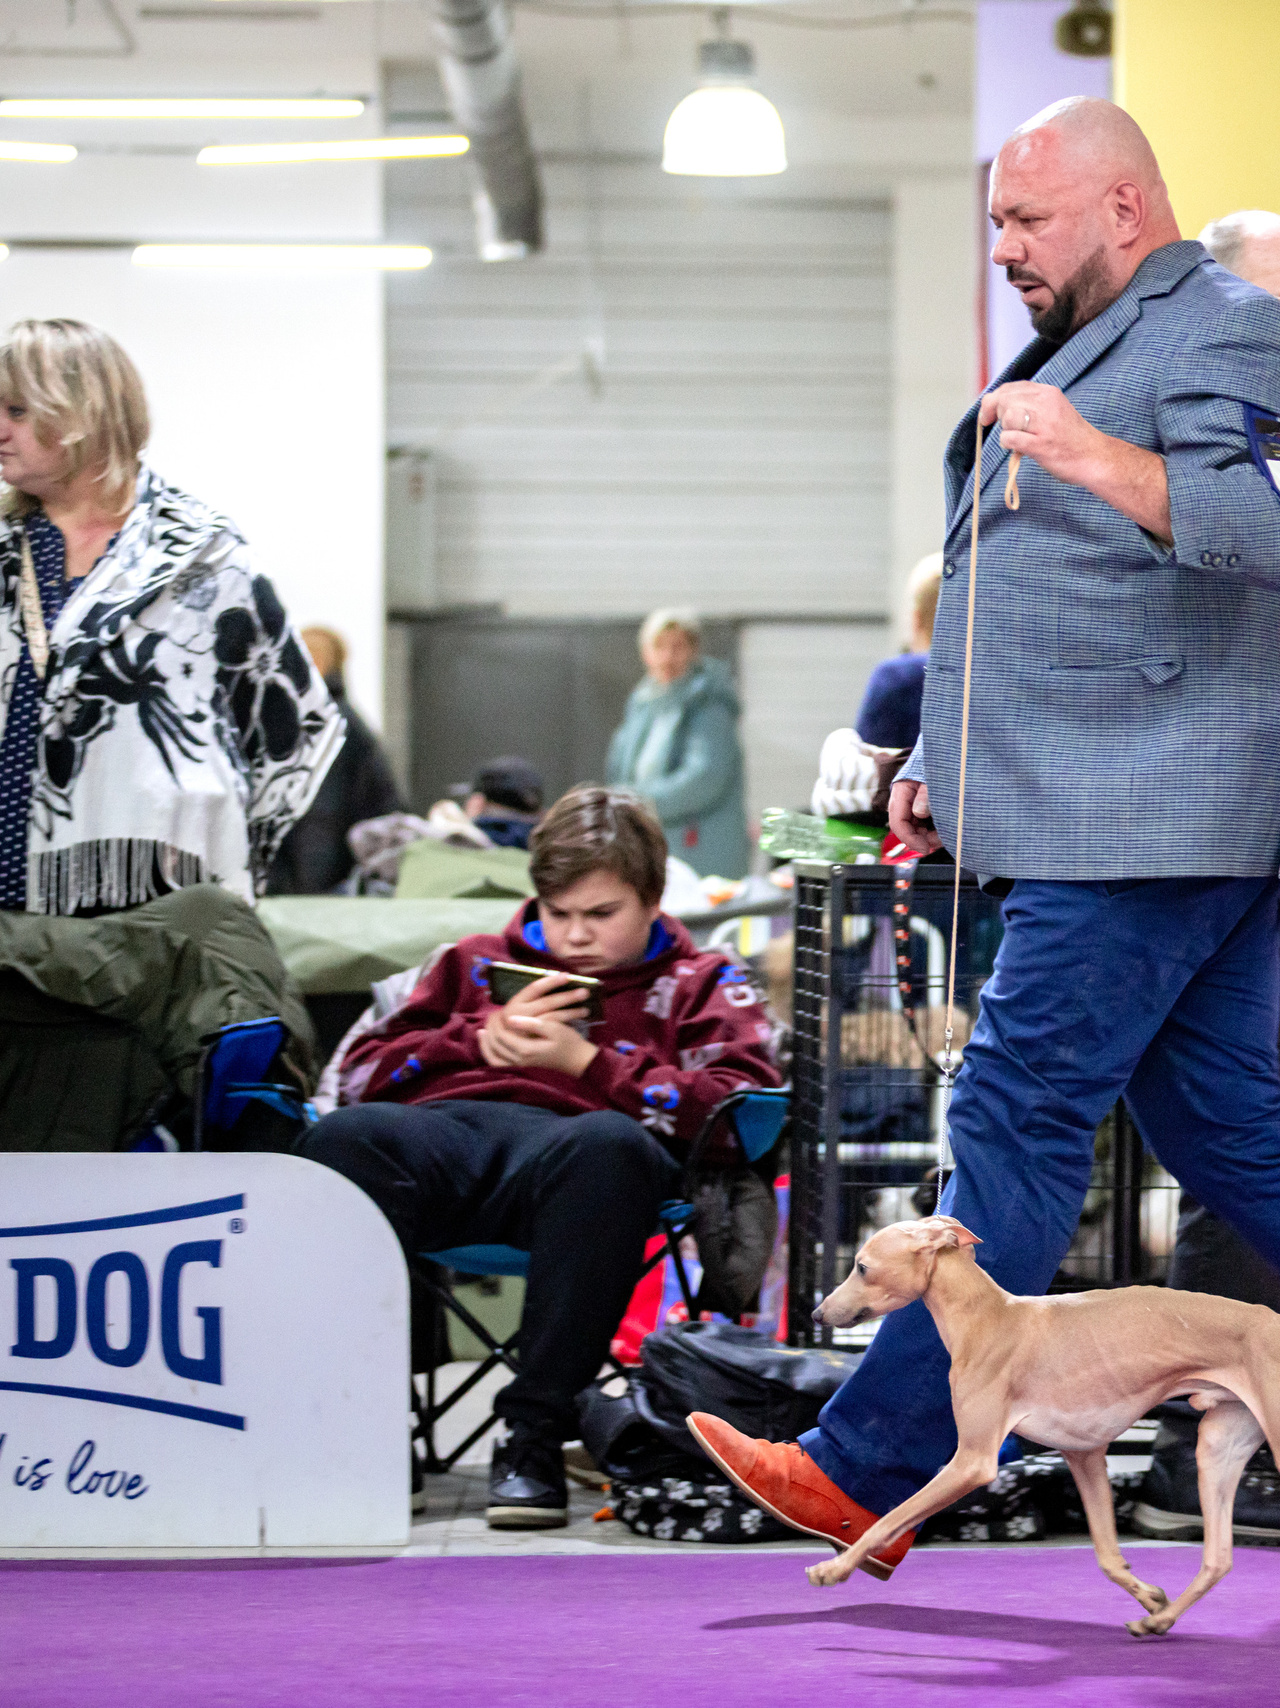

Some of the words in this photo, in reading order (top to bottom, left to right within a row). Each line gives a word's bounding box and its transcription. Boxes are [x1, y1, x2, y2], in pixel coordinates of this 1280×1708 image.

[9, 1239, 224, 1386] DOG
[14, 1456, 53, 1491] is
[66, 1440, 149, 1500] love
